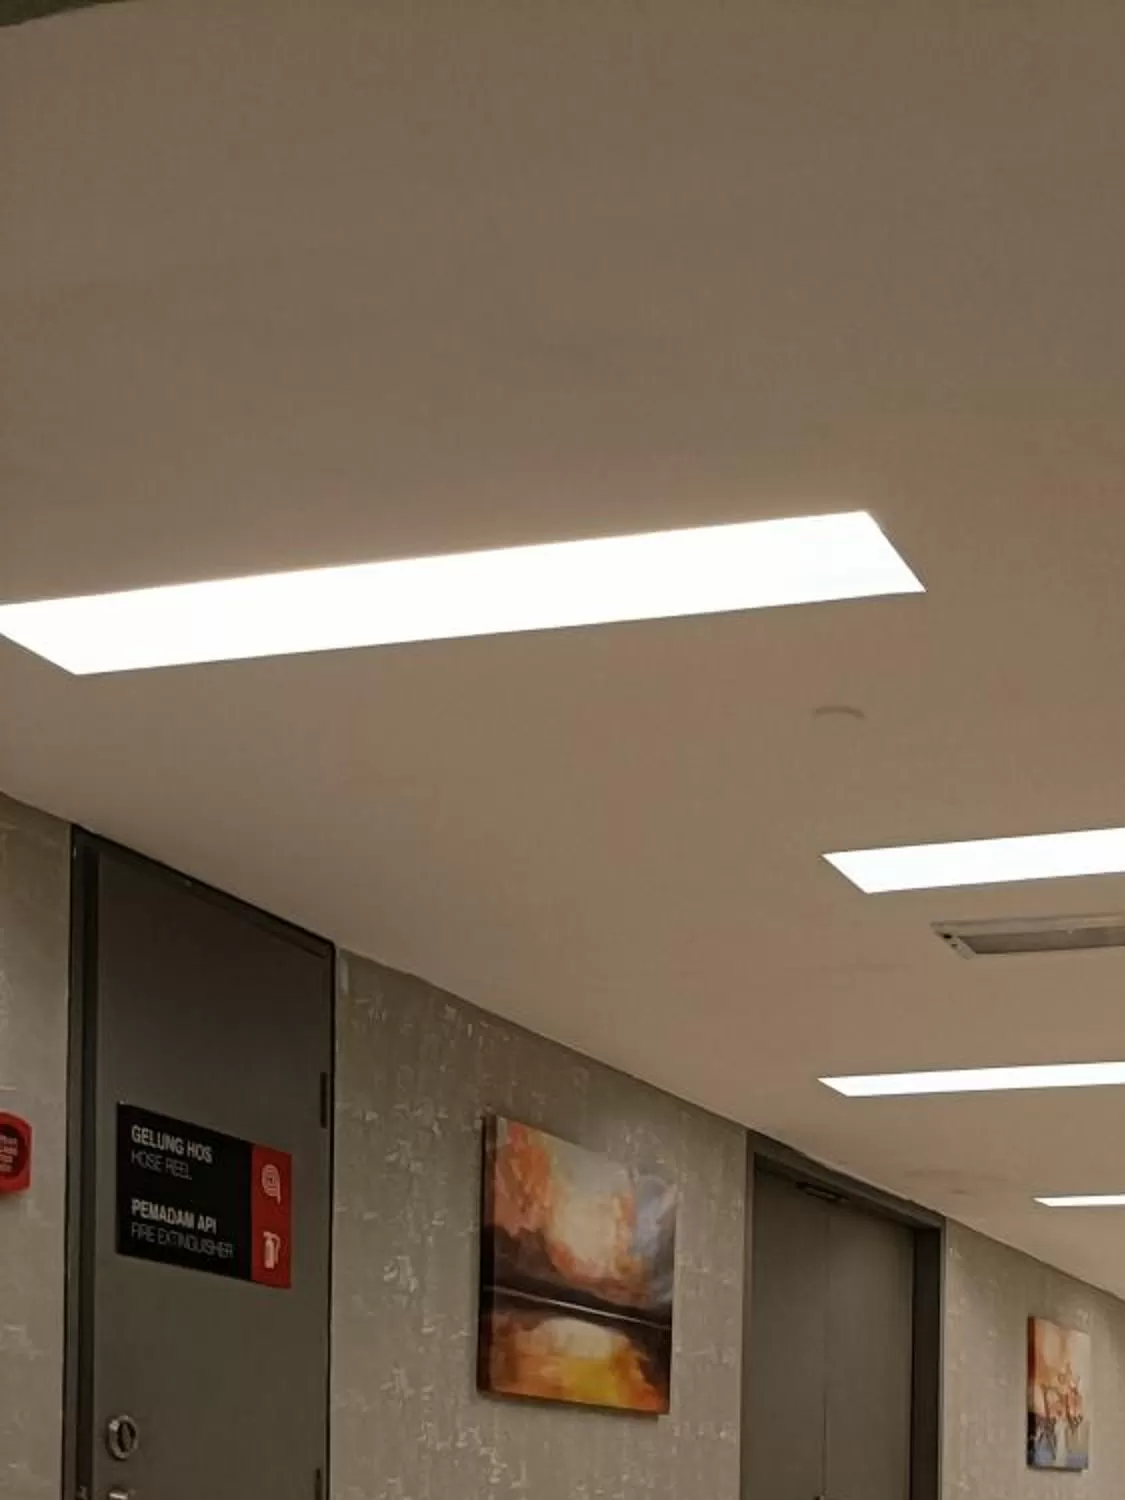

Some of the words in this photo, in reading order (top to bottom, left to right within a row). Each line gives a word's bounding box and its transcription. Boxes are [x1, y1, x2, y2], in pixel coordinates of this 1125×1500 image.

[131, 1123, 184, 1155] GELUNG
[187, 1140, 213, 1164] HOS
[131, 1148, 163, 1173] HOSE
[165, 1157, 192, 1180] REEL
[131, 1197, 195, 1229] PEMADAM
[197, 1213, 217, 1235] API
[131, 1221, 156, 1243] FIRE
